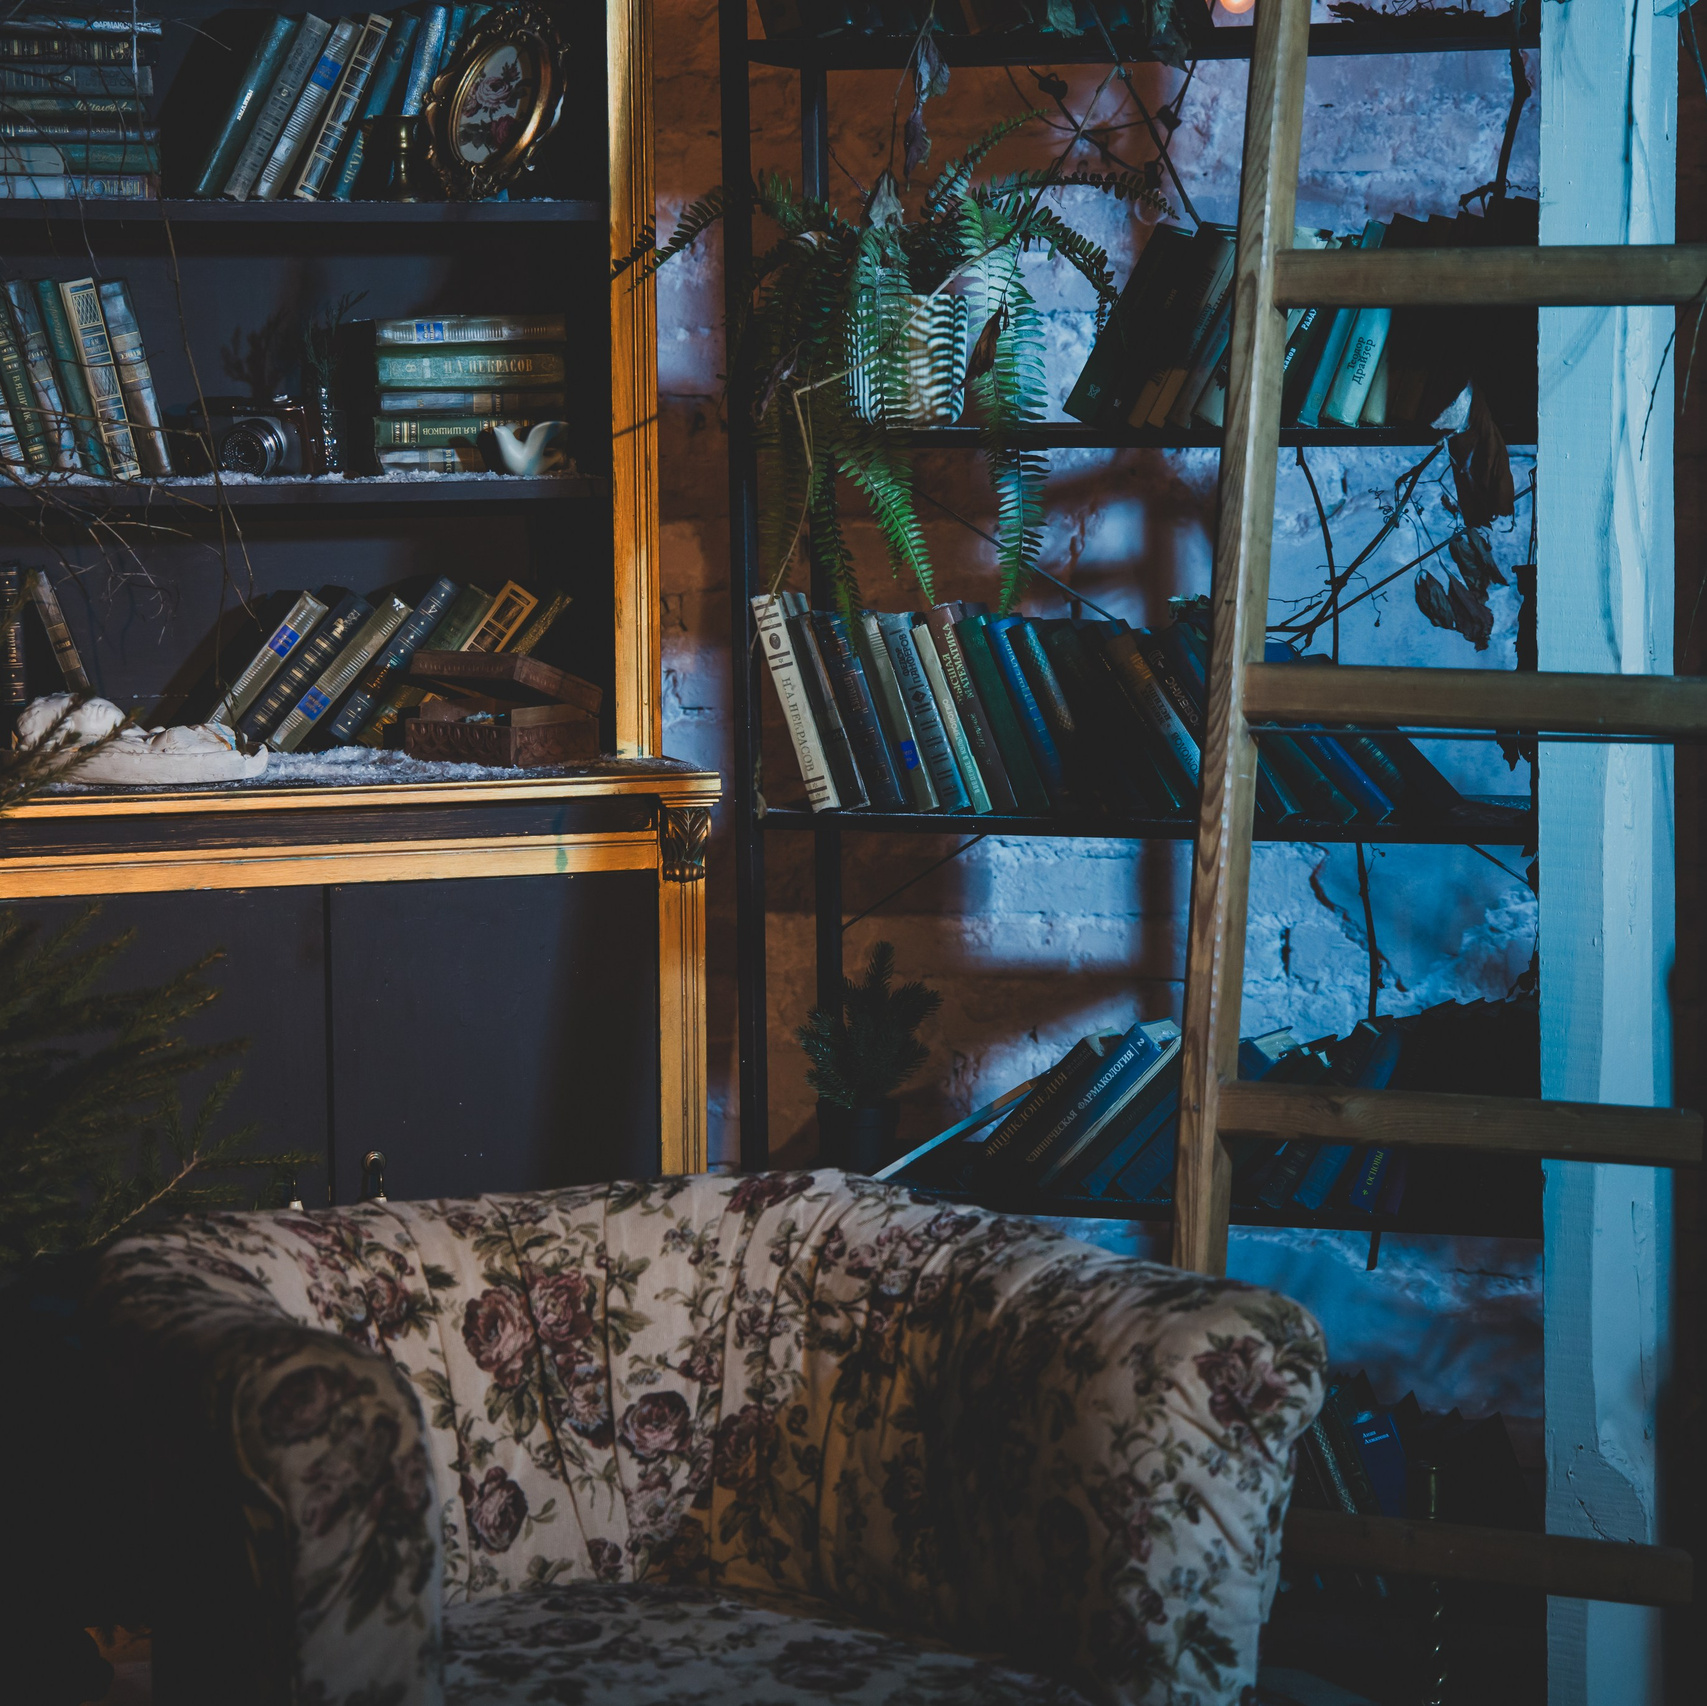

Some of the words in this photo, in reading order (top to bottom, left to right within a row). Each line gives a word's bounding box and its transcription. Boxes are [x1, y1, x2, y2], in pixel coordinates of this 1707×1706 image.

[280, 87, 290, 98] 5
[1347, 336, 1366, 370] Теодор
[1352, 338, 1376, 385] Драйзер
[422, 426, 477, 436] В.Я.ШИШКОВ
[896, 648, 910, 677] ФЕДОР
[898, 633, 923, 684] ПАНФЕРОВ
[941, 621, 974, 700] МАТЕМАТИКА
[781, 677, 814, 772] Н.А.НЕКРАСОВ
[1136, 1037, 1145, 1048] 2
[1026, 1109, 1078, 1162] КЛИНИЧЕСКАЯ
[1077, 1049, 1135, 1110] ФАРМАКОЛОГИЯ
[1366, 1150, 1385, 1186] ОСНОВЫ
